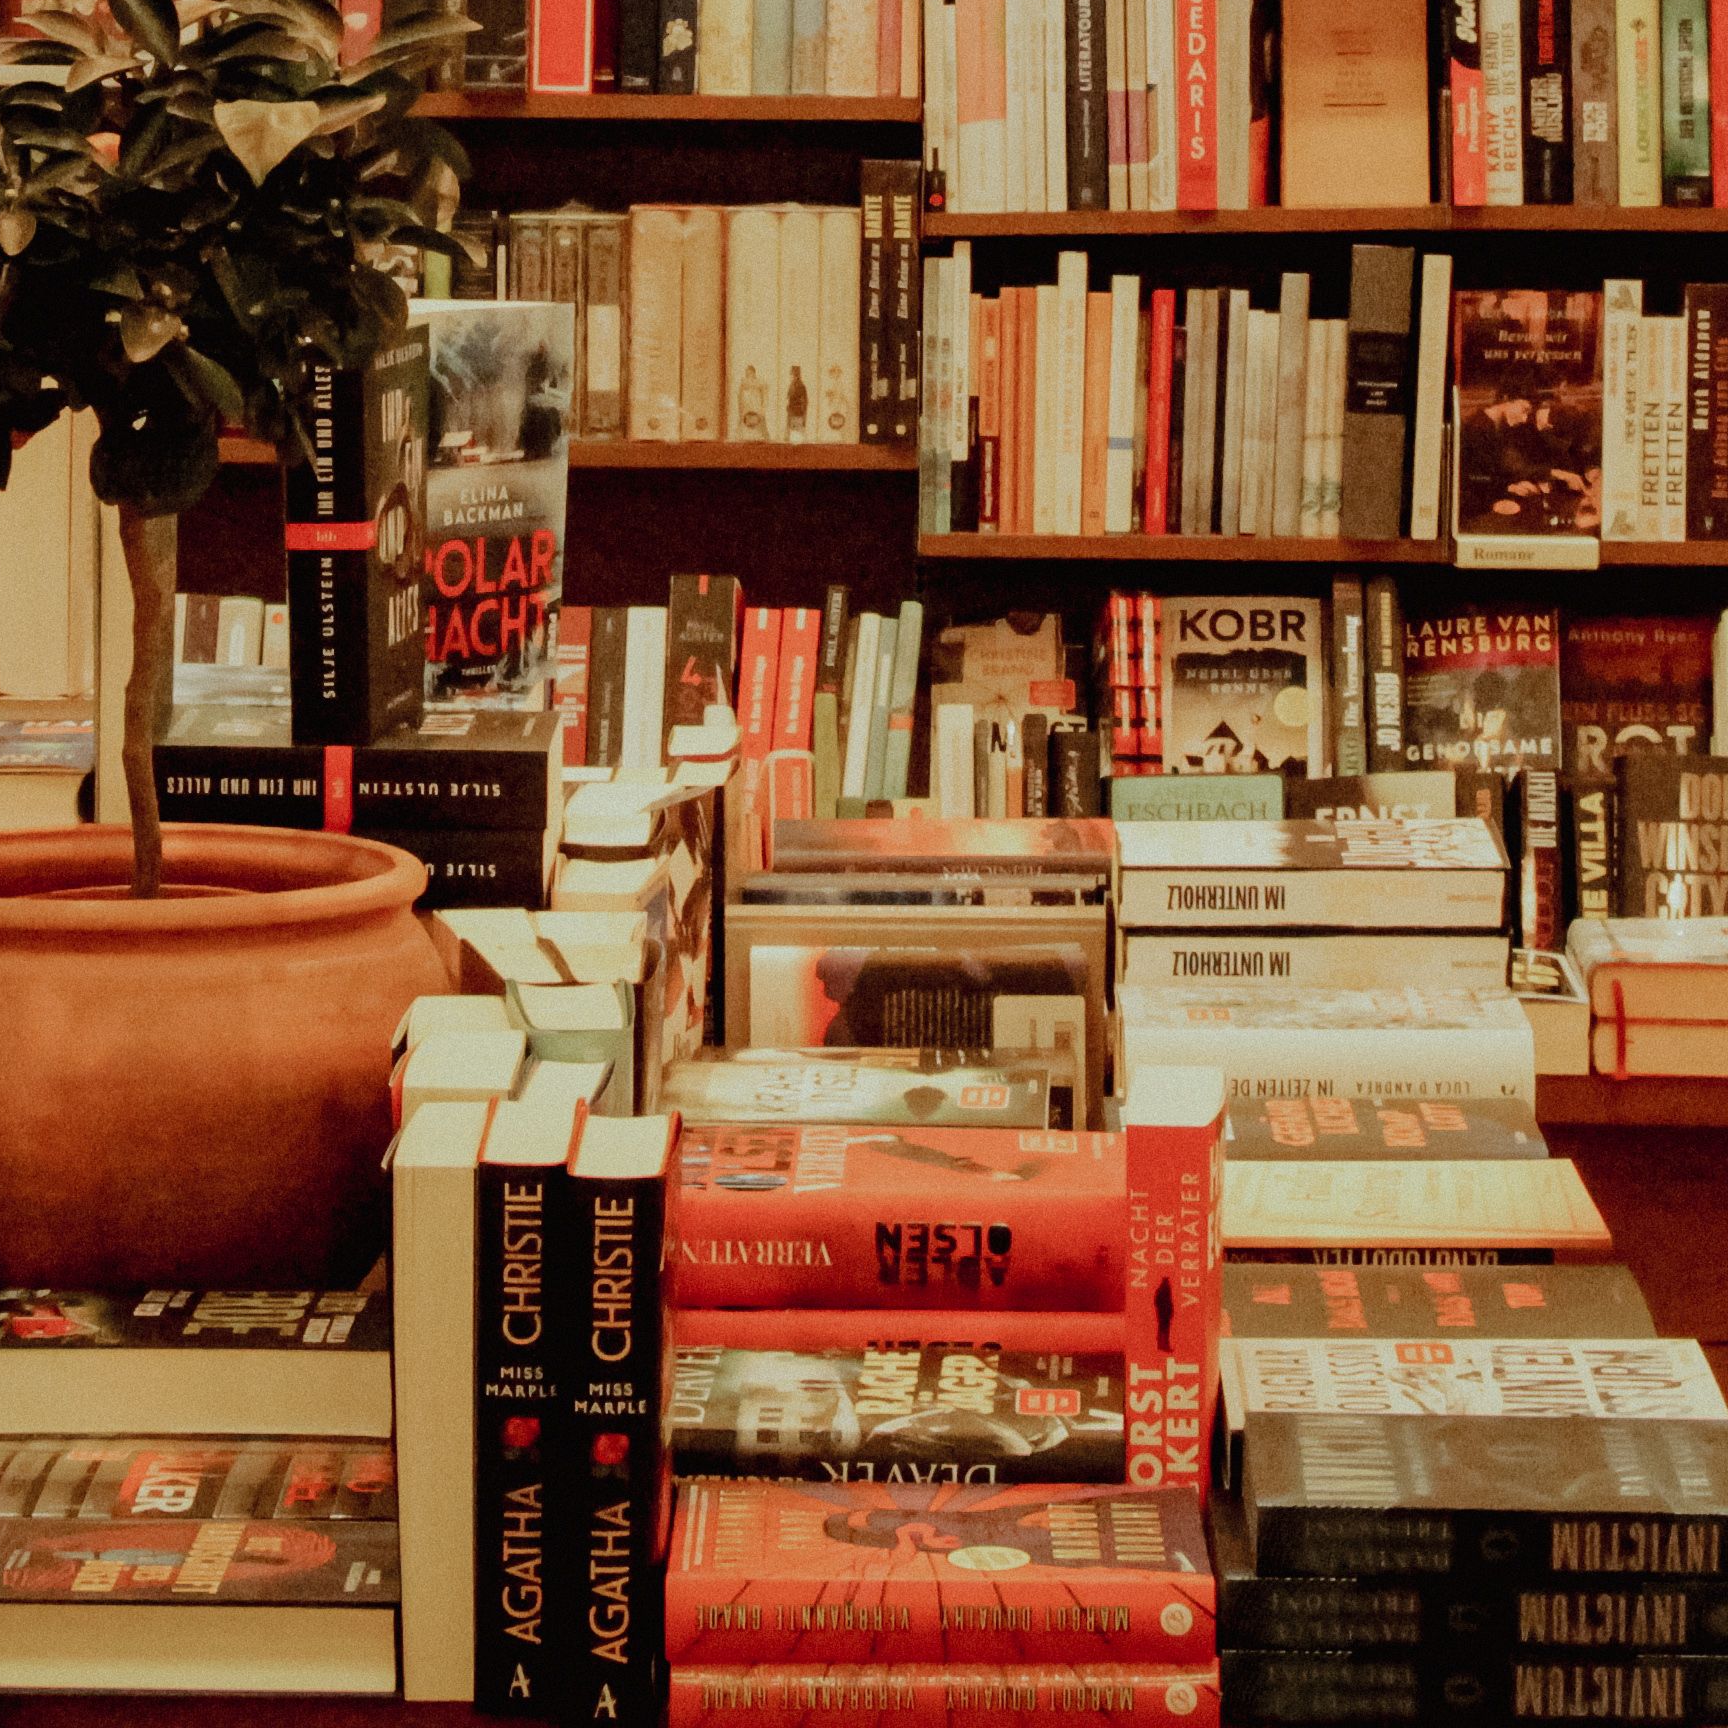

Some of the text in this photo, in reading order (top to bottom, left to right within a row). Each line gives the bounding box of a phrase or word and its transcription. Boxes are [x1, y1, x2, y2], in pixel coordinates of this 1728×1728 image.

[1485, 112, 1501, 173] KATHY
[1501, 105, 1518, 173] REICHS
[864, 195, 882, 239] DANTE
[893, 195, 912, 239] DANTE
[1642, 402, 1661, 507] FRETTEN
[1665, 402, 1684, 507] FRETTEN
[459, 485, 509, 506] ELINA
[442, 502, 524, 526] BACKMAN
[316, 417, 338, 698] SILJE ULSTEIN EIN UND
[1472, 546, 1535, 562] Romane
[1178, 608, 1307, 643] KOBR
[1405, 615, 1550, 639] LAURE VAN
[1567, 628, 1646, 647] Anthony
[1405, 635, 1552, 658] RENSBURG
[165, 775, 501, 798] SILJE ULSTEIN IHR EIN UND ALLES
[1577, 792, 1607, 882] VILLA
[1168, 884, 1286, 911] IM UNTERHOLZ
[1173, 951, 1291, 976] IM UNTERHOLZ
[1256, 1078, 1334, 1097] IN ZEITEN
[681, 1238, 833, 1267] VERRATEN
[875, 1221, 1012, 1256] OLSEN
[1128, 1188, 1149, 1289] NACHT
[1155, 1213, 1175, 1264] DER
[1176, 1172, 1201, 1308] VERRÄTER
[500, 1366, 546, 1380] MISS
[588, 1382, 635, 1397] MISS
[485, 1384, 559, 1399] MARPLE
[574, 1399, 648, 1415] MARPLE
[502, 1181, 544, 1645] AGATHA CHRISTIE
[590, 1196, 635, 1664] AGATHA CHRISTIE
[1551, 1521, 1720, 1572] INVICTUM
[692, 1604, 1130, 1631] MARGOT DOUAIHY VERBRANNTE GNADE
[1518, 1593, 1687, 1643] INVICTUM
[1515, 1665, 1684, 1715] INVICTUM
